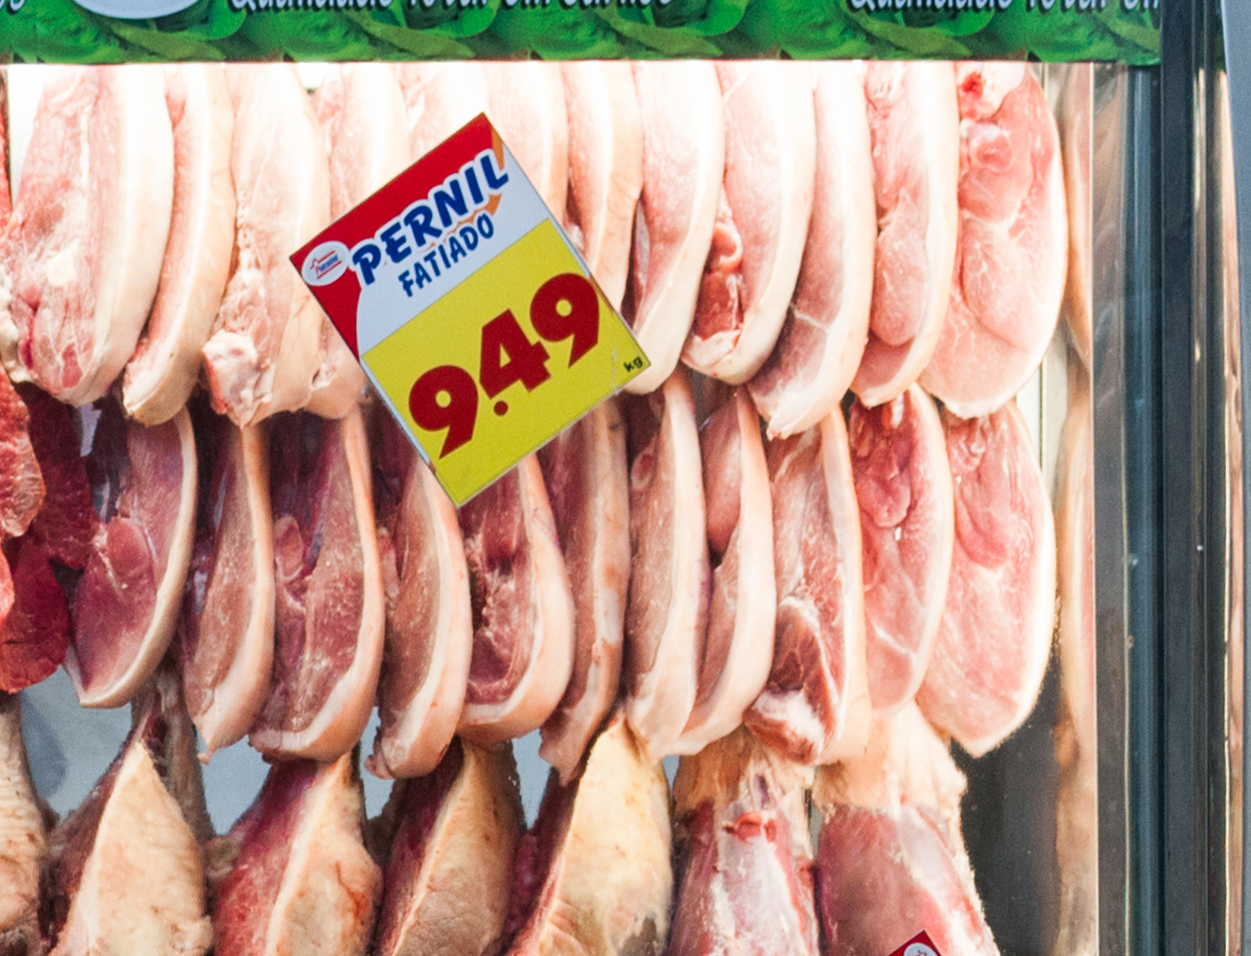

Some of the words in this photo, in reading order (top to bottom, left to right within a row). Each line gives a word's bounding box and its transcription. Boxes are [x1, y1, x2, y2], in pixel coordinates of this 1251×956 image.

[352, 155, 509, 285] PERNIL
[398, 214, 494, 297] FATIADO
[408, 273, 600, 459] 9.49
[623, 356, 643, 372] kg
